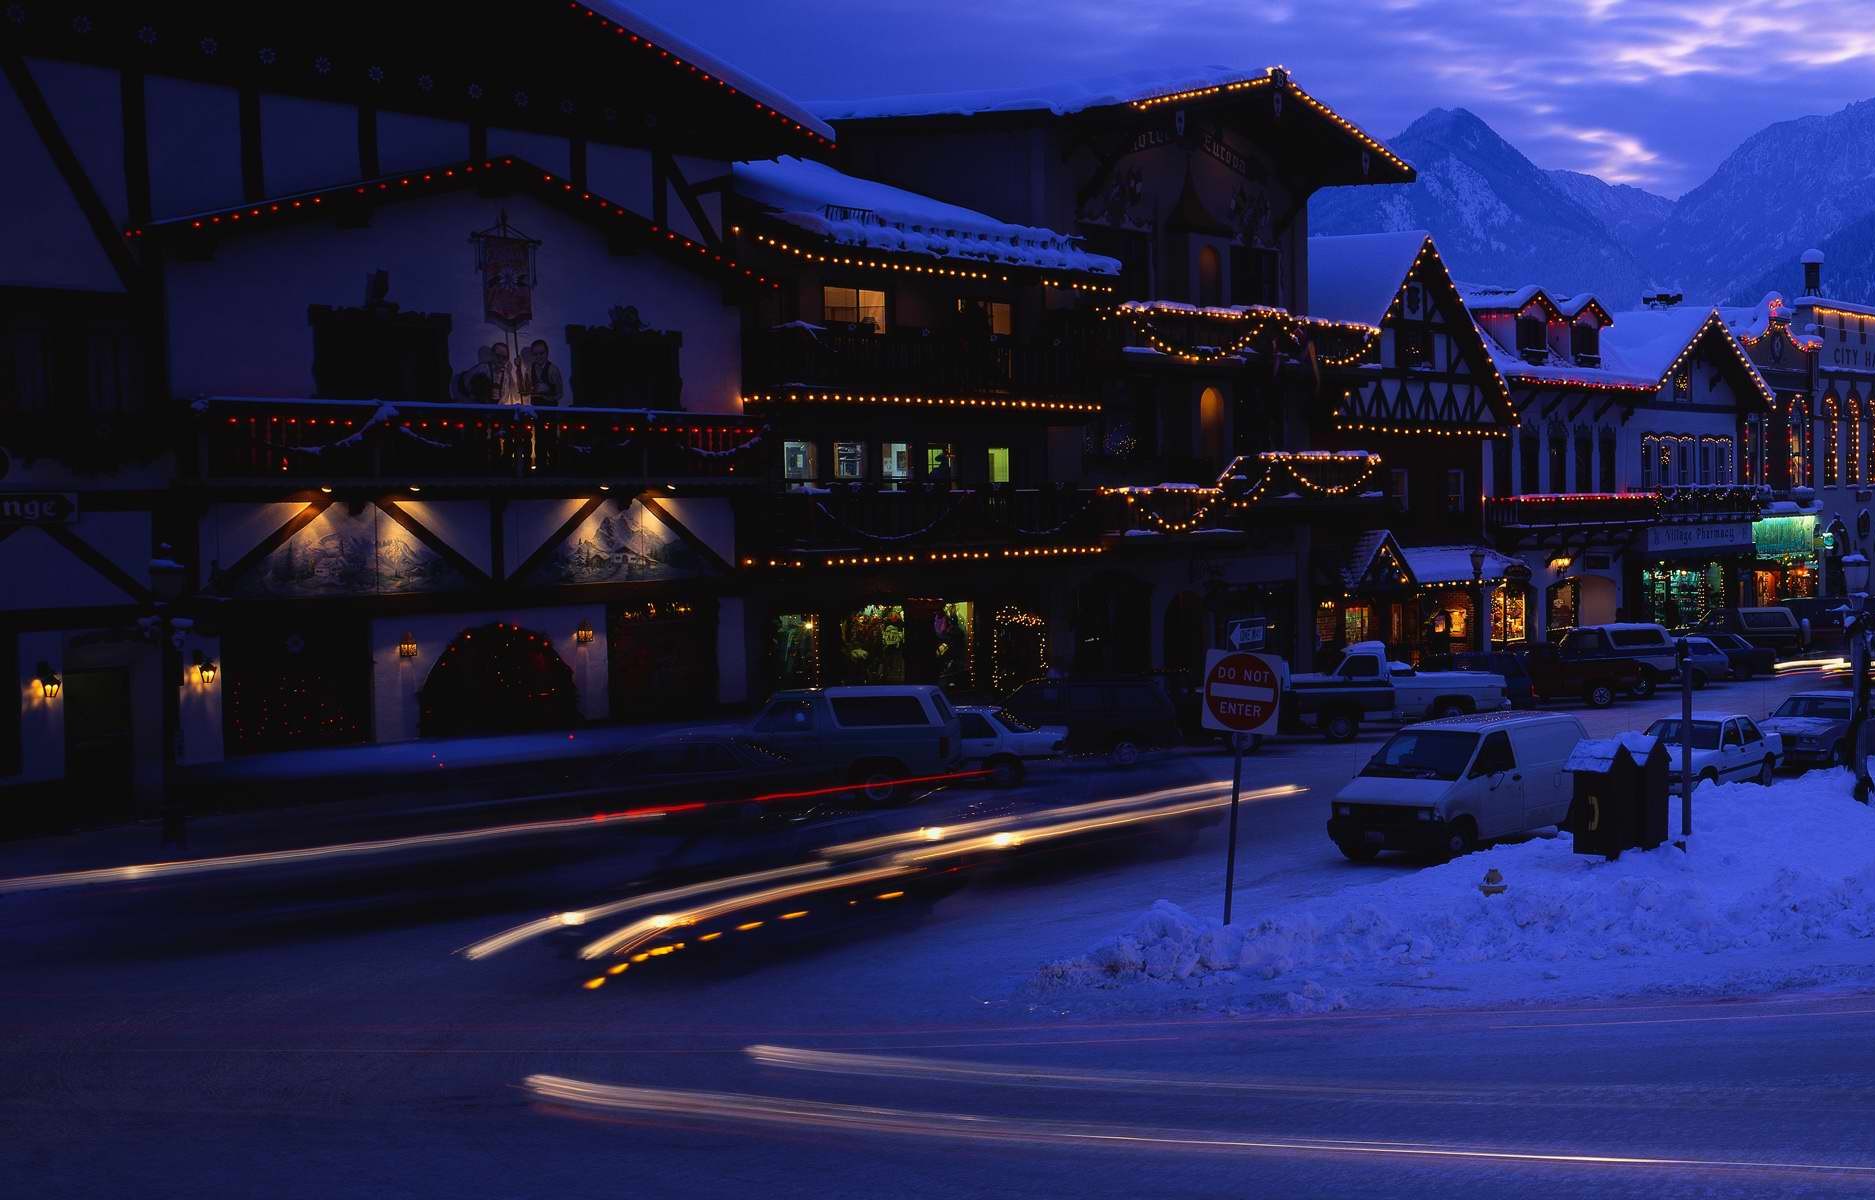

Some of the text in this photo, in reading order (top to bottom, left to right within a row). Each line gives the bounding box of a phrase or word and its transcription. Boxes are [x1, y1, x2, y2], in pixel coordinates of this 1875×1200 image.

[1834, 348, 1857, 365] CITY
[1664, 527, 1734, 544] Village Pharmacy
[1217, 666, 1270, 684] DO NOT
[1219, 701, 1261, 717] ENTER
